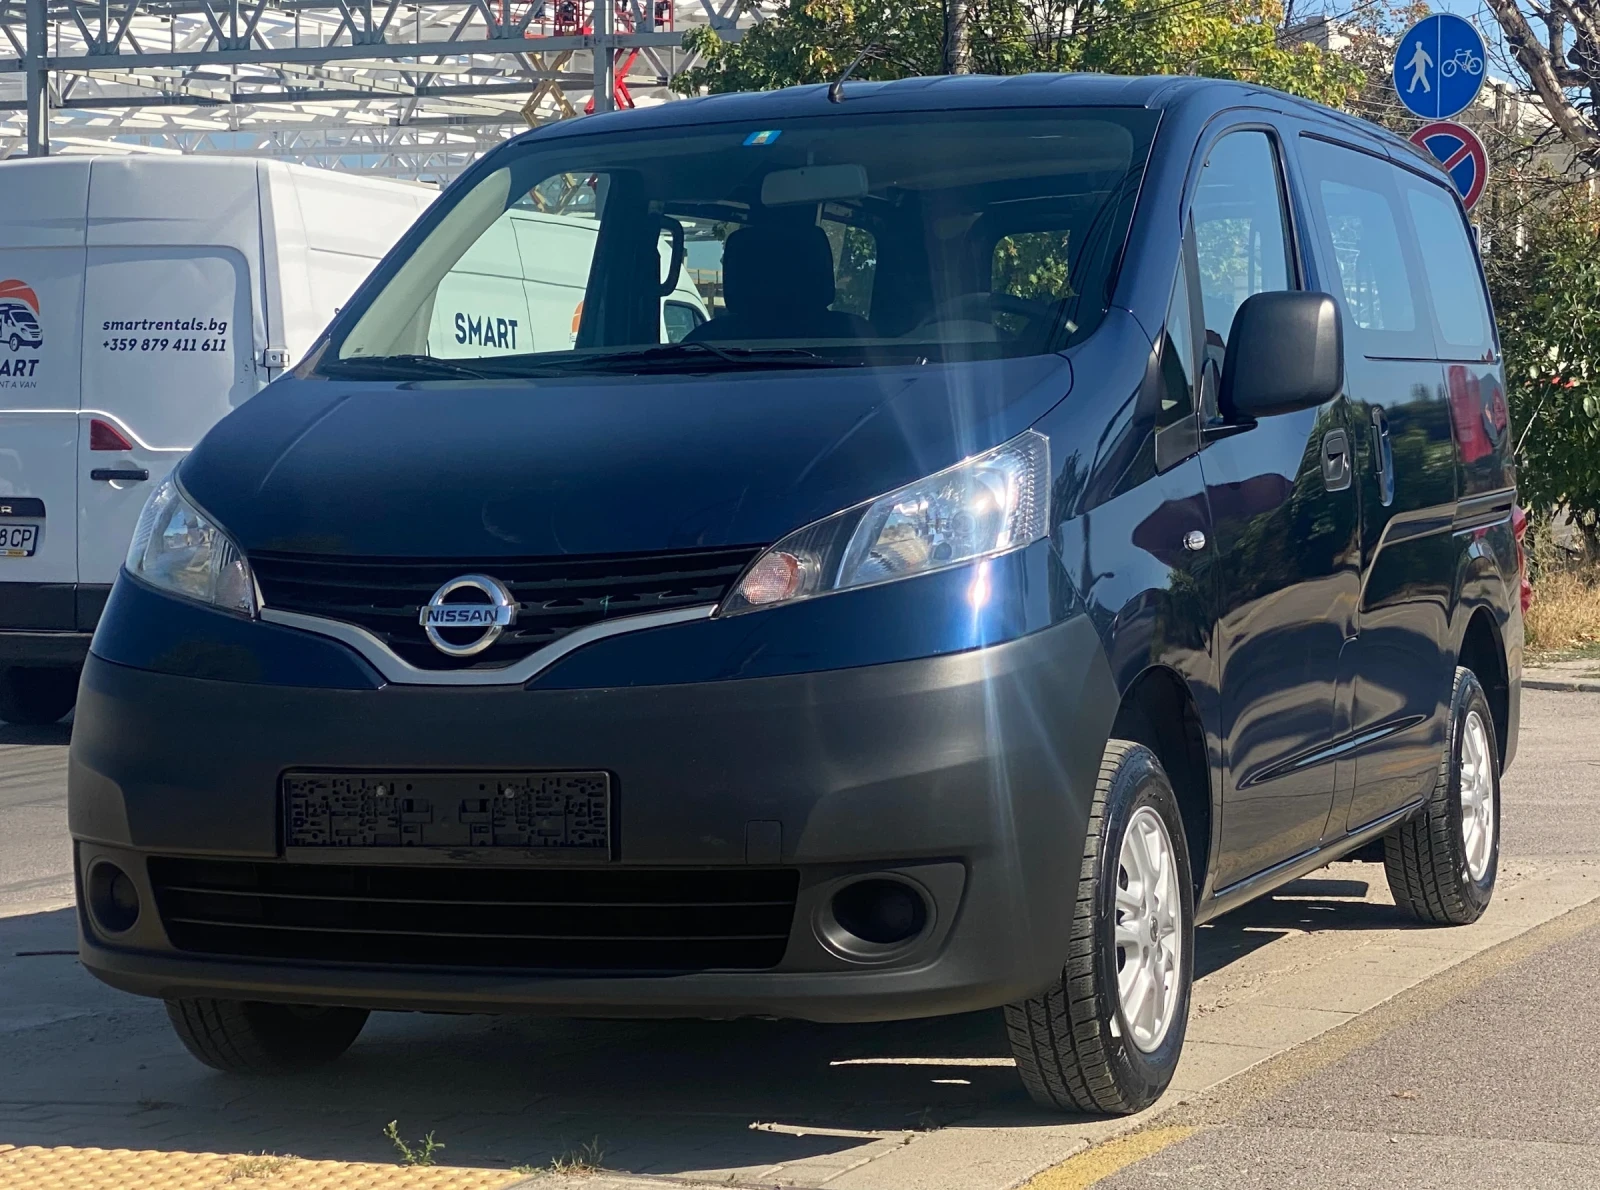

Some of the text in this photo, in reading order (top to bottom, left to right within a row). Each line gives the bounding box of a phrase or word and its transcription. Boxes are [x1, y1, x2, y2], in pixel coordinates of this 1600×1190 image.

[102, 317, 228, 335] smartrentals.bg
[455, 312, 518, 350] SMART
[102, 338, 226, 352] +359 879 411 611
[19, 381, 37, 389] VAN
[10, 529, 32, 547] CP
[427, 609, 499, 622] NISSAN
